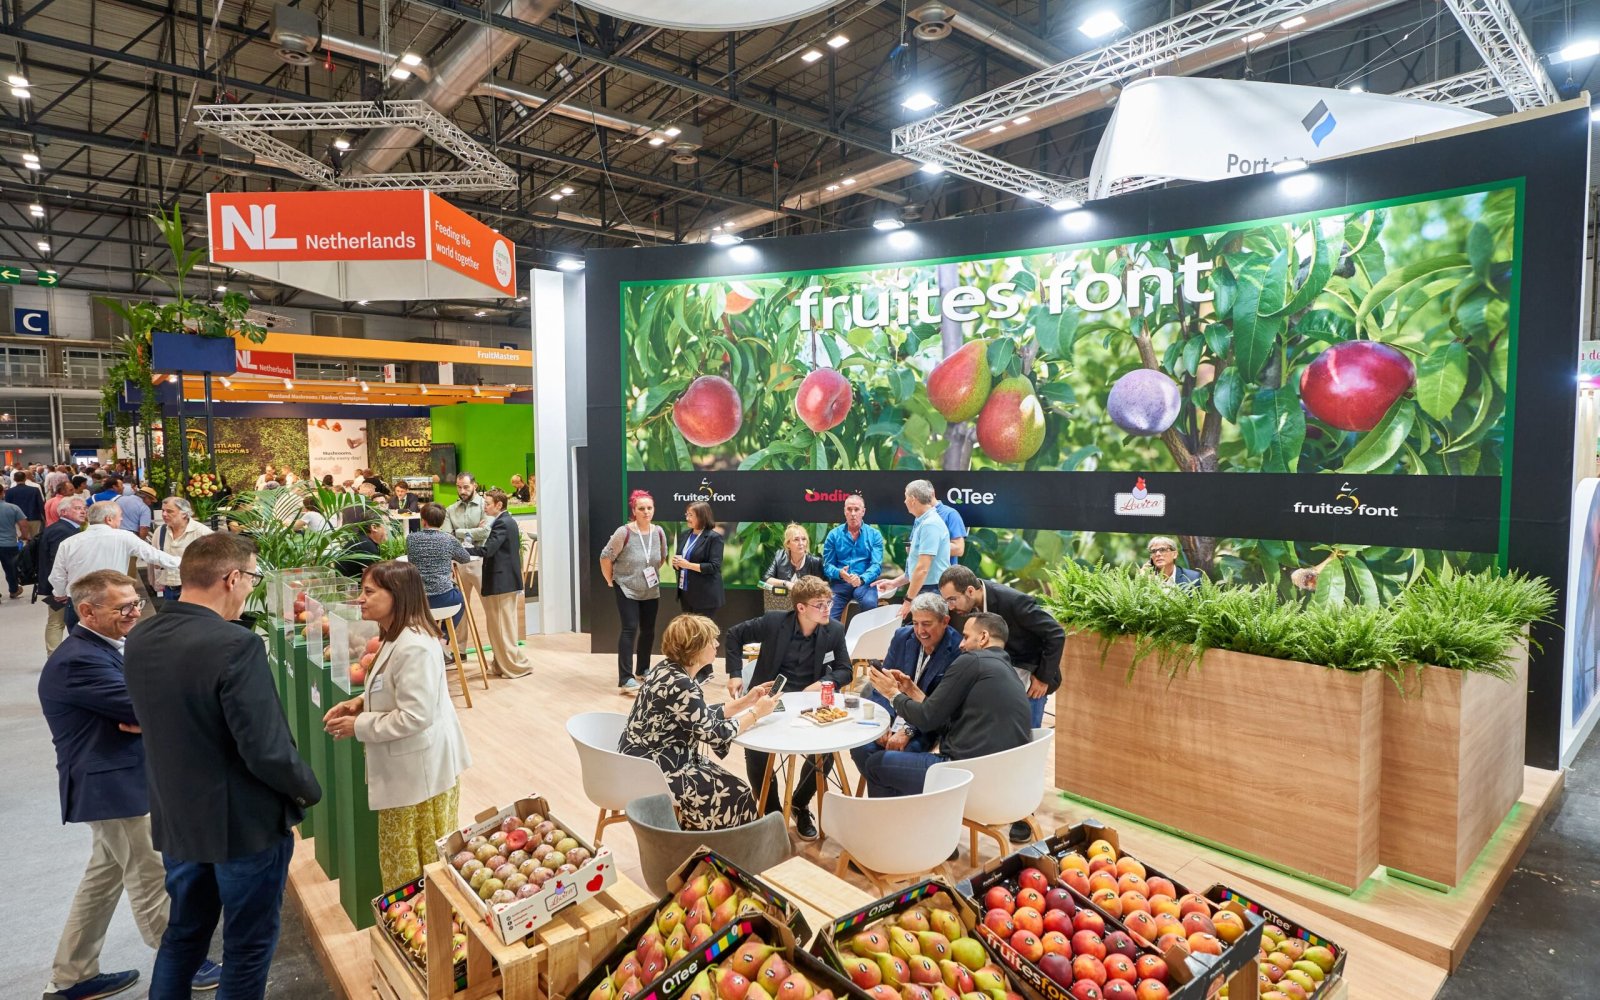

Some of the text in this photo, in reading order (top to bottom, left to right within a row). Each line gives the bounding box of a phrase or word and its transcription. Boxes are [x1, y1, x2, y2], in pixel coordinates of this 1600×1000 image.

[220, 204, 298, 250] NL
[435, 220, 471, 248] Feeding the
[305, 231, 416, 250] Netherlands
[435, 243, 479, 270] world together
[795, 252, 1215, 331] fruites font
[22, 313, 42, 331] C
[477, 351, 520, 360] FruitMasters
[259, 365, 292, 375] Netherlands
[380, 436, 427, 447] Banken
[673, 492, 736, 501] fruites font
[947, 487, 996, 504] QTee
[1293, 502, 1399, 517] fruites font
[1262, 910, 1291, 930] QTee
[662, 960, 698, 994] QTee
